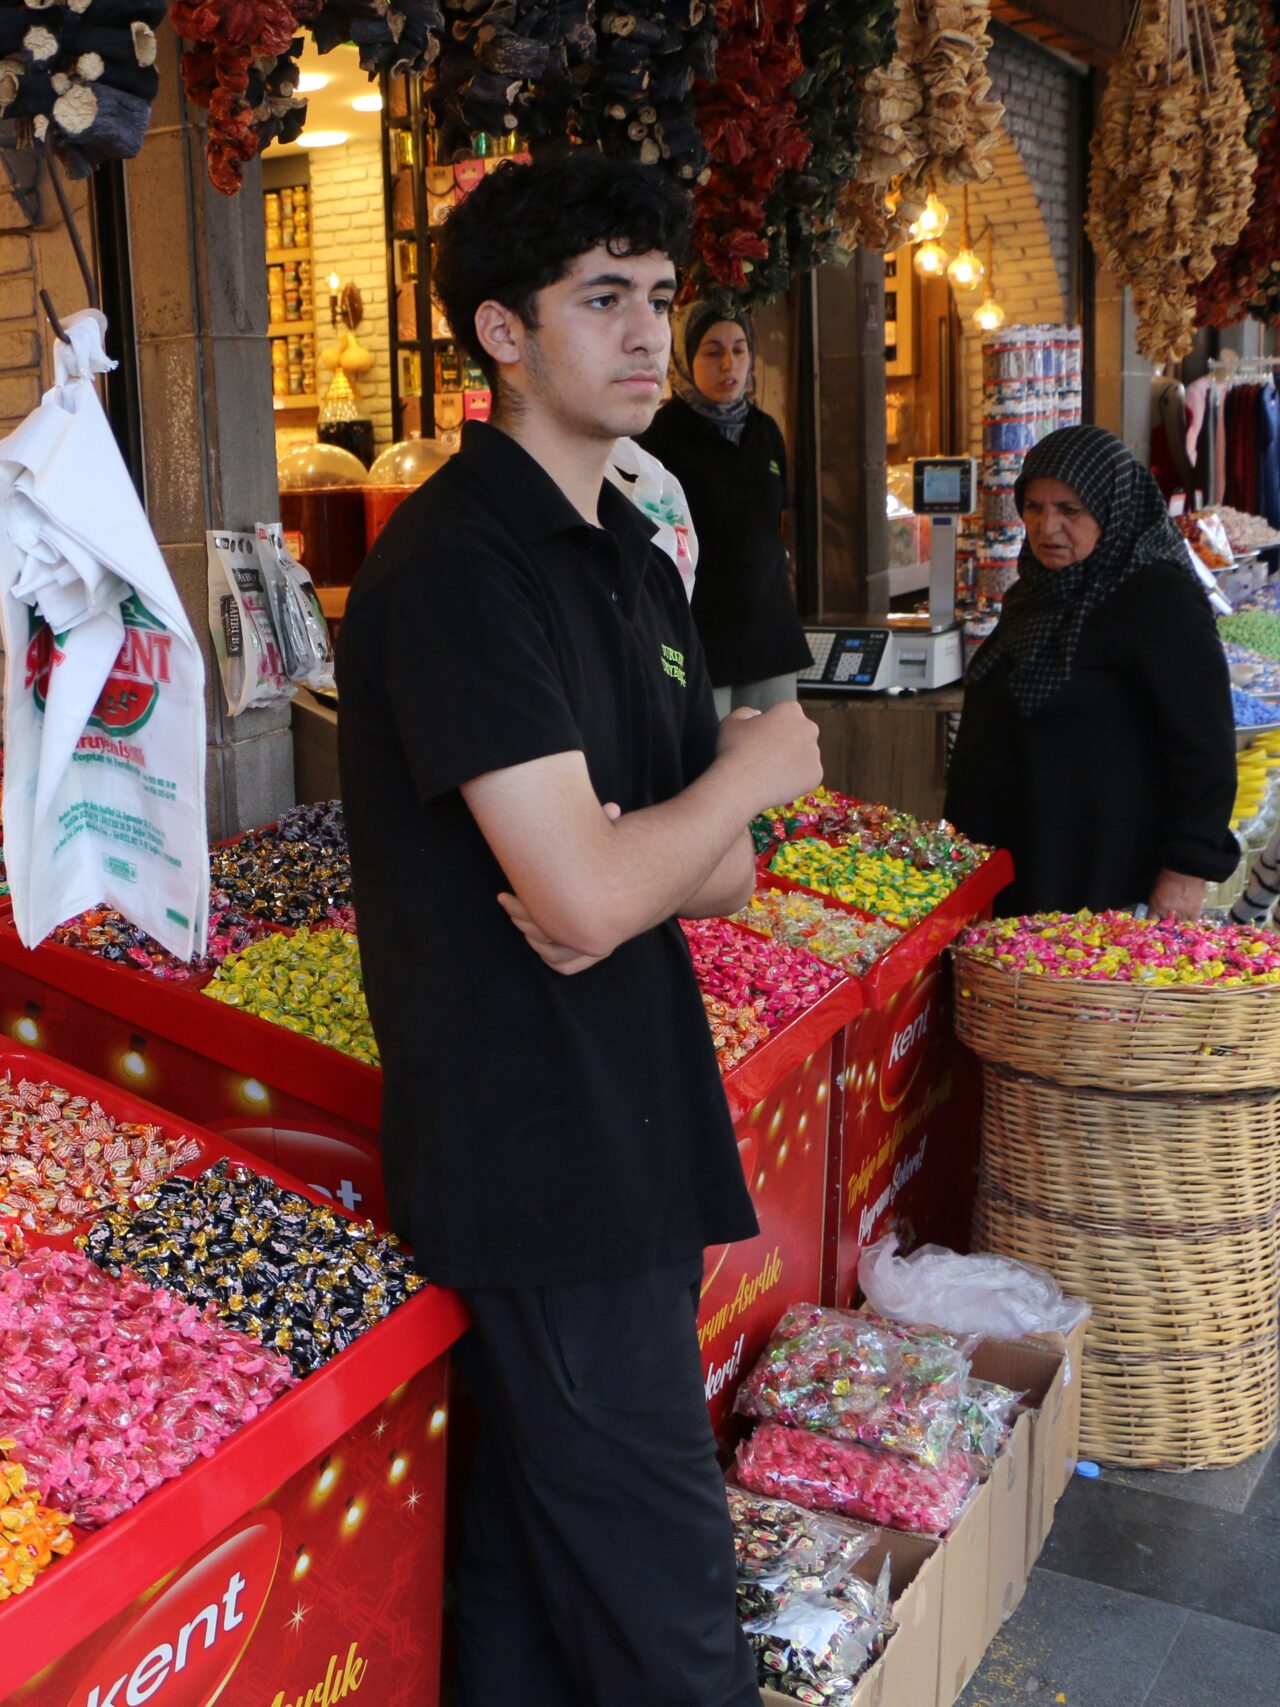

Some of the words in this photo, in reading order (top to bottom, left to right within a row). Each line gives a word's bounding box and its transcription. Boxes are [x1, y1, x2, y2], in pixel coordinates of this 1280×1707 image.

[888, 1000, 930, 1070] kent
[729, 1246, 783, 1323] Asırlık
[704, 1333, 745, 1402] keri!
